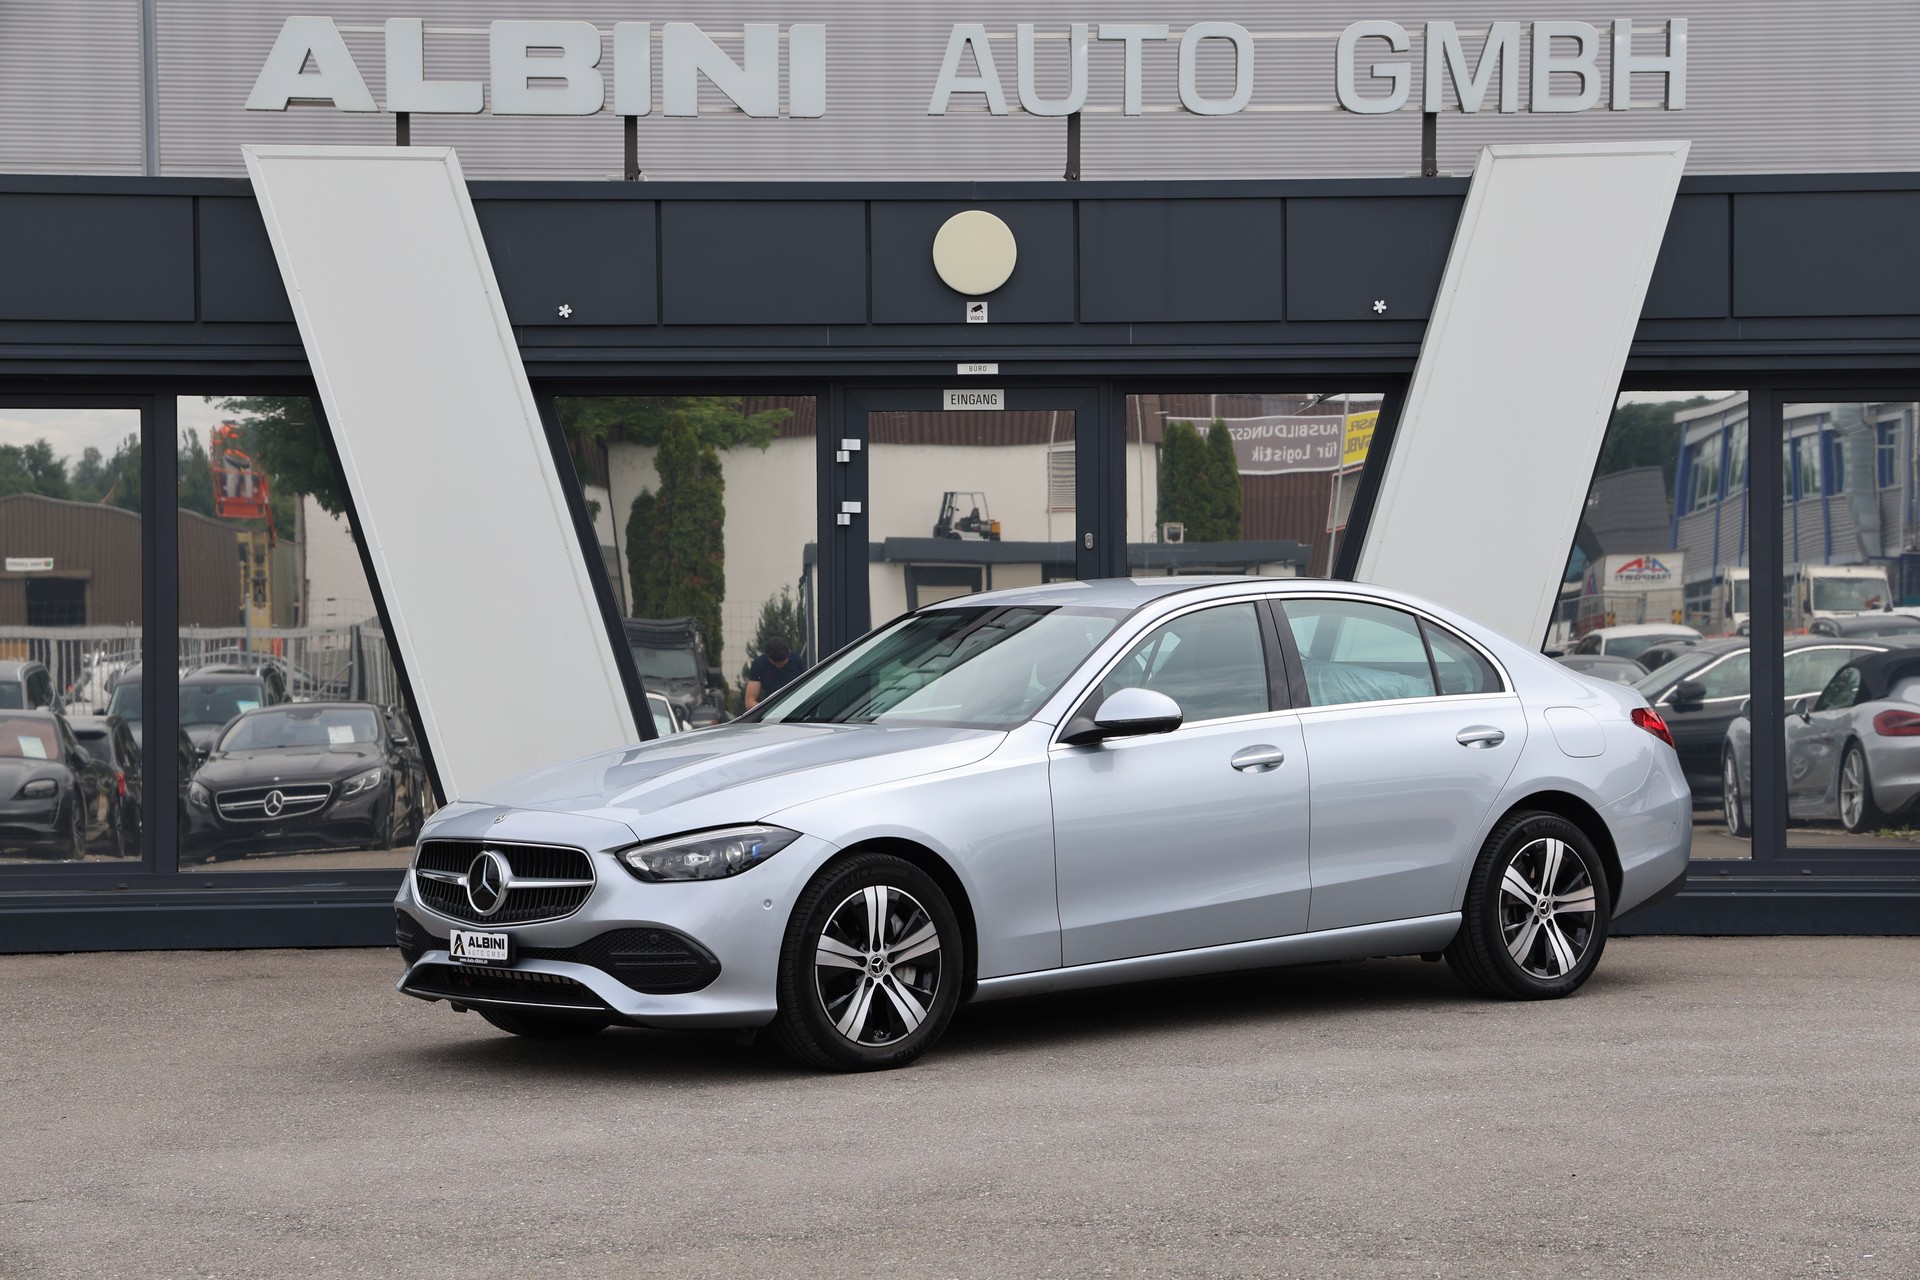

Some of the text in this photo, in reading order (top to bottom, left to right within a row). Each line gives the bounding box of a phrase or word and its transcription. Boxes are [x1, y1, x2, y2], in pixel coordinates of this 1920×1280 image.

[244, 16, 1688, 118] ALBINI AUTO GMBH
[950, 393, 997, 405] EINGANG
[468, 936, 504, 950] ALBINI
